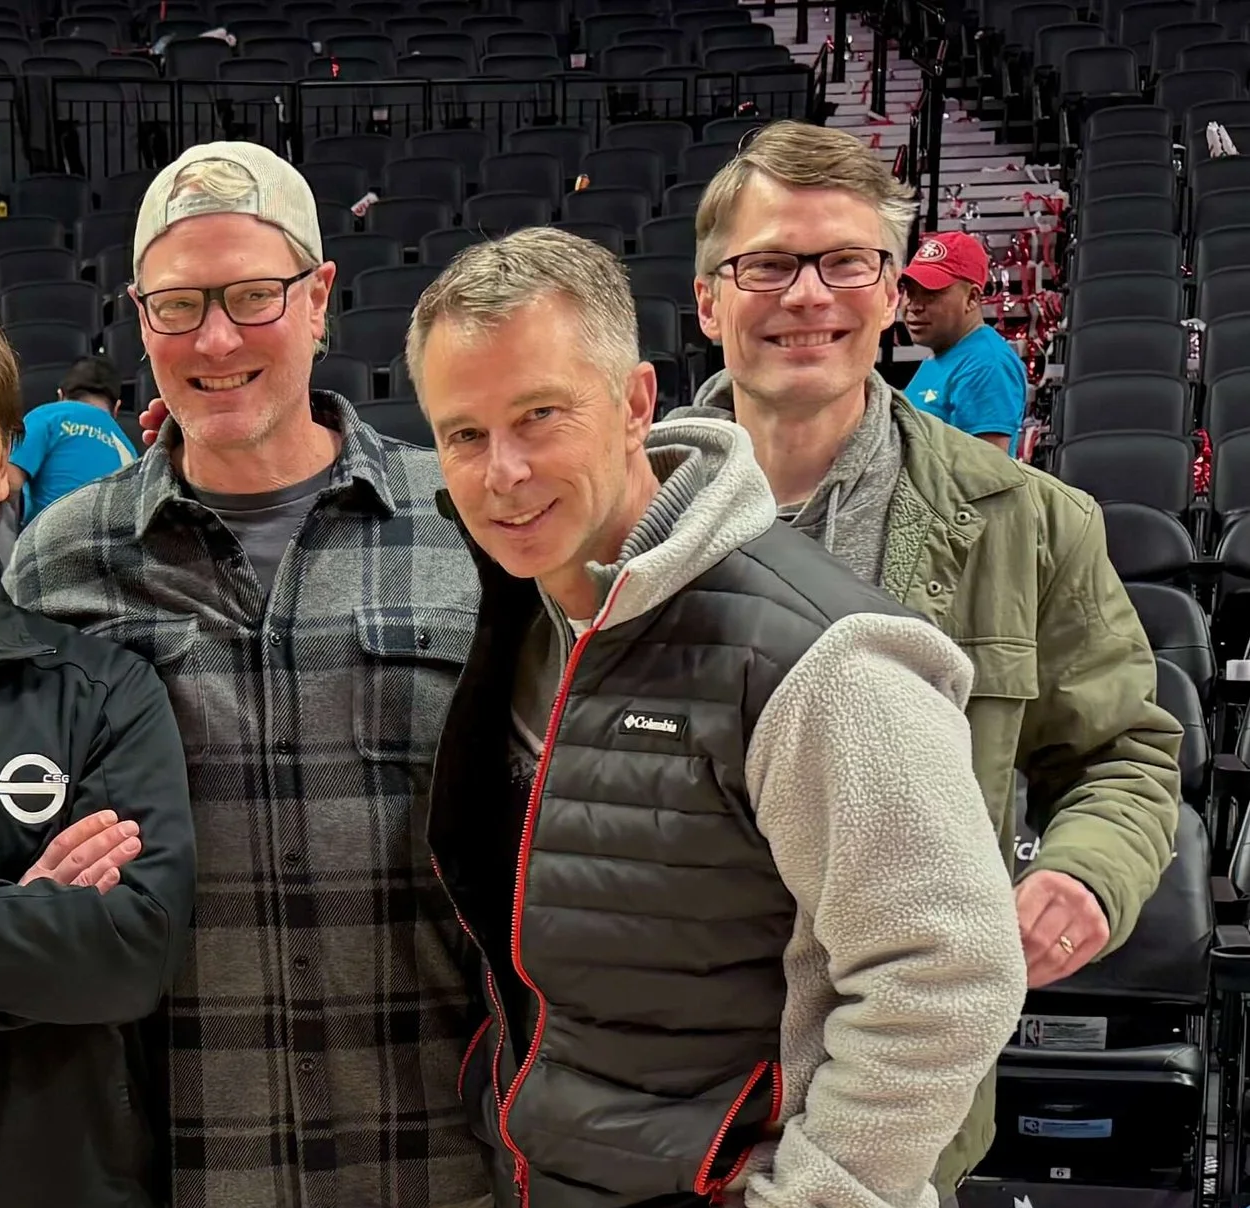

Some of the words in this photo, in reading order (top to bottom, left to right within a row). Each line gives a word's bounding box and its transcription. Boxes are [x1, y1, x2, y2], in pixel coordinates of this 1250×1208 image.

[60, 420, 116, 448] Service
[634, 716, 678, 733] Columbia
[42, 774, 70, 784] CSG
